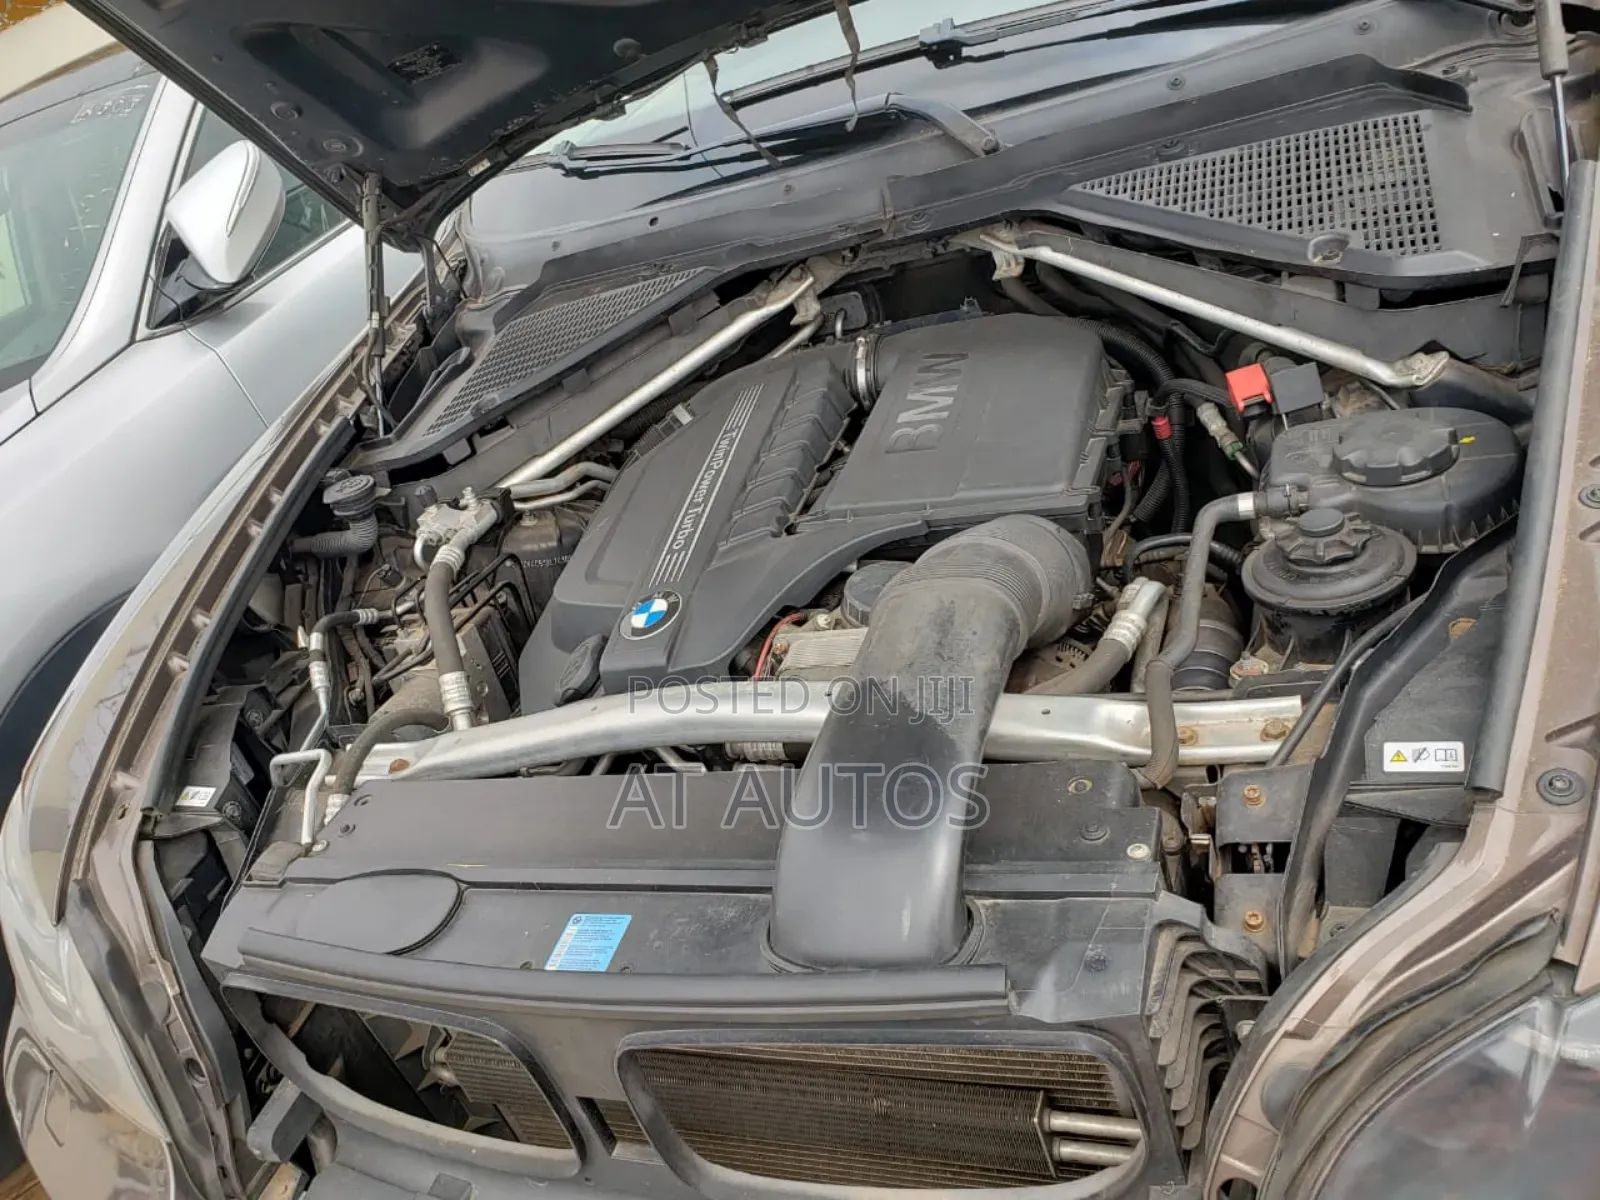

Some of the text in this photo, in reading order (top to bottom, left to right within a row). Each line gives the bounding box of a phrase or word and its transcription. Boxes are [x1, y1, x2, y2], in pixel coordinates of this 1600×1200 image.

[884, 353, 969, 455] BMW
[672, 427, 740, 550] TwinPower Turbo
